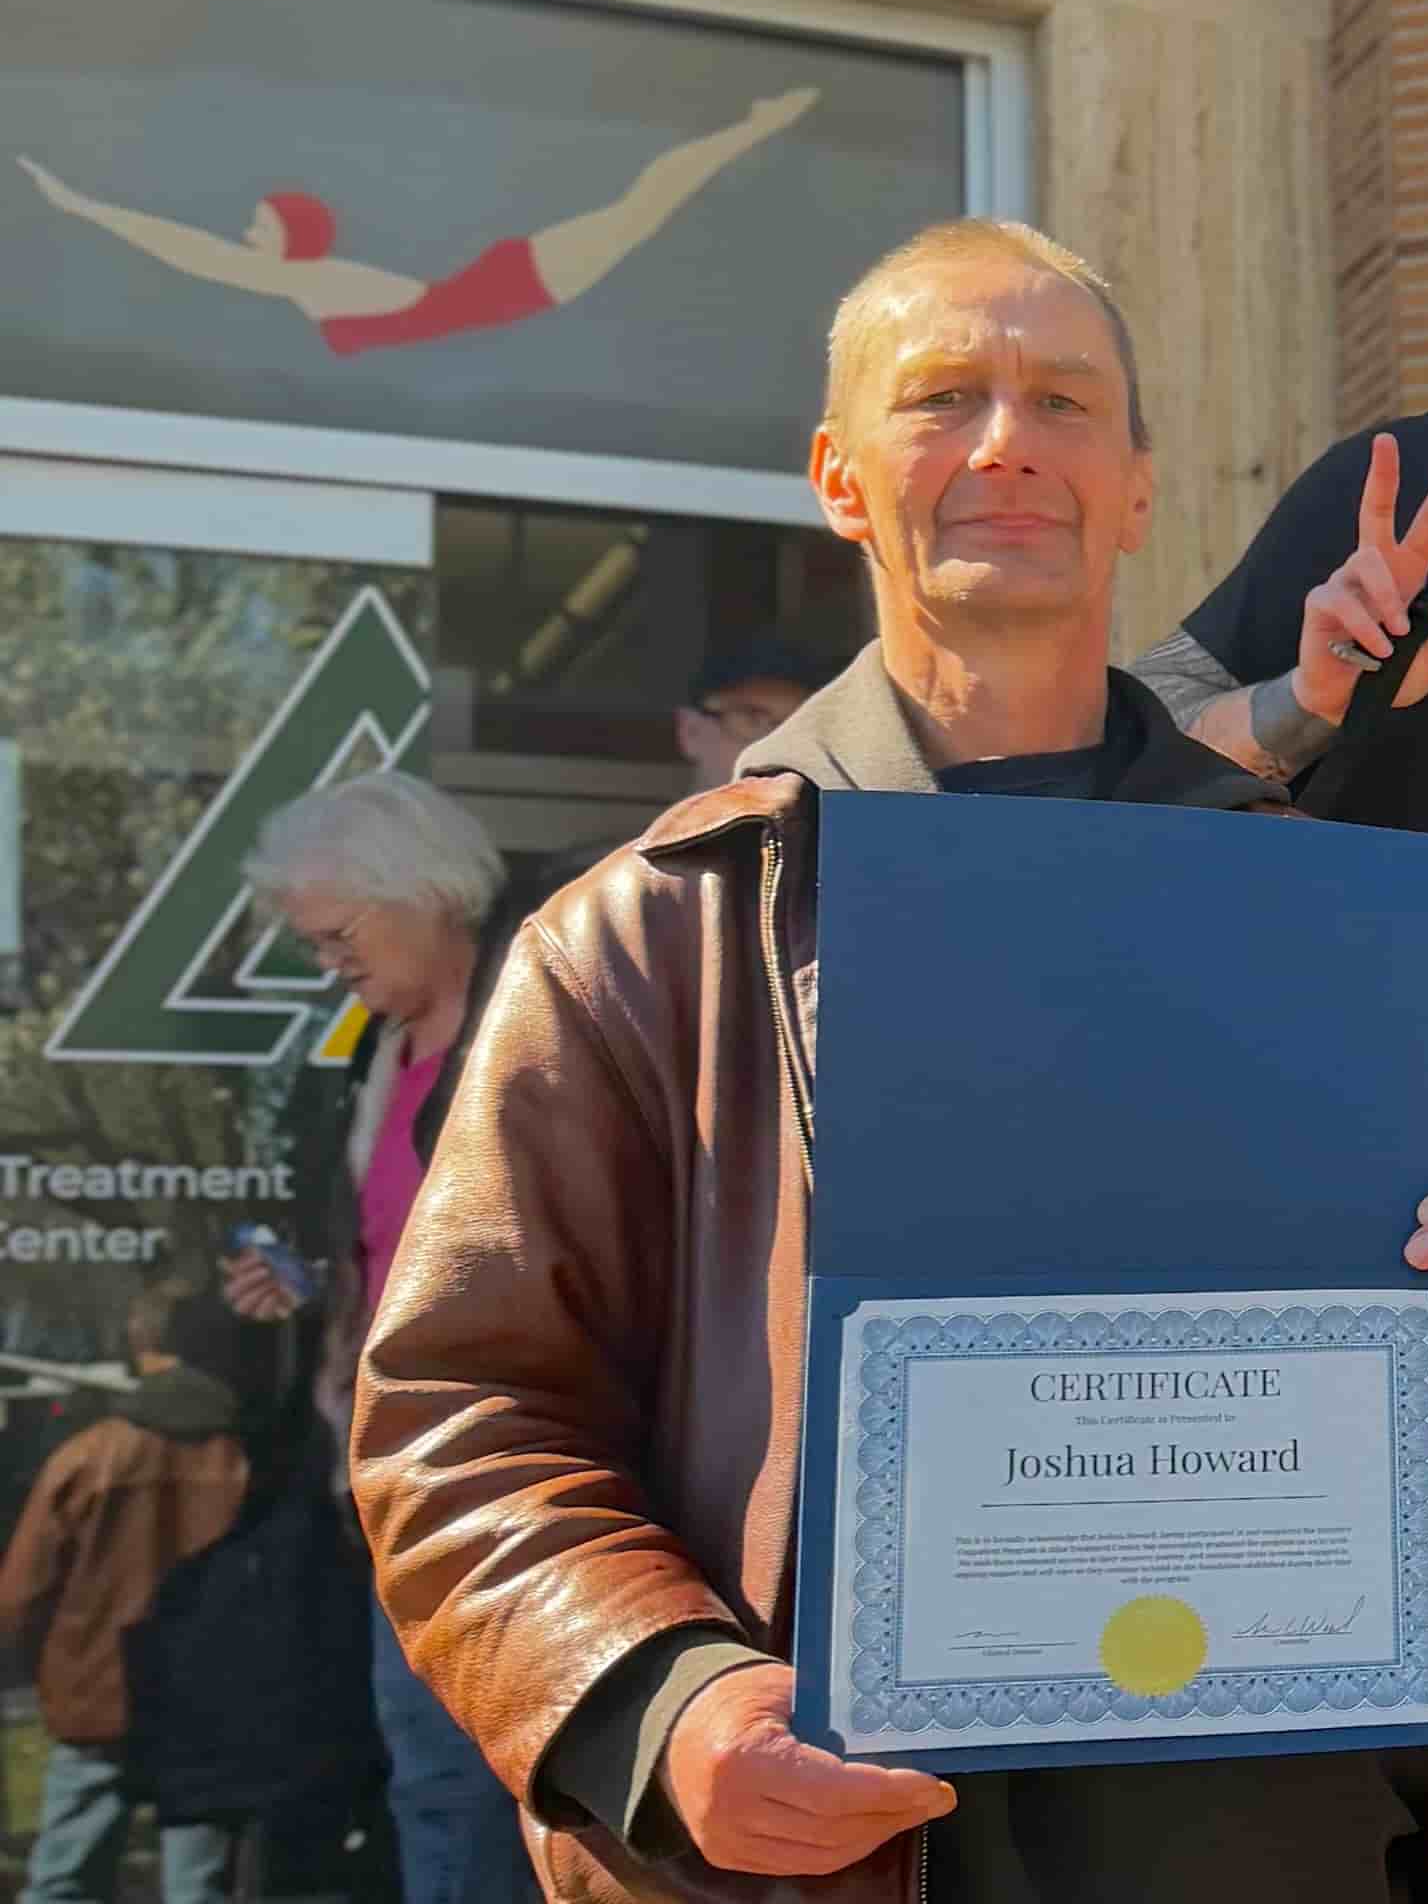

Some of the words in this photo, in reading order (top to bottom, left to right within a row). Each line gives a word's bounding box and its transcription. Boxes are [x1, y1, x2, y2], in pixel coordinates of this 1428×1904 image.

[0, 1154, 296, 1200] Treatment
[0, 1220, 168, 1263] enter
[1030, 1368, 1281, 1403] CERTIFICATE
[1000, 1444, 1136, 1487] Joshua
[1148, 1438, 1301, 1476] Howard
